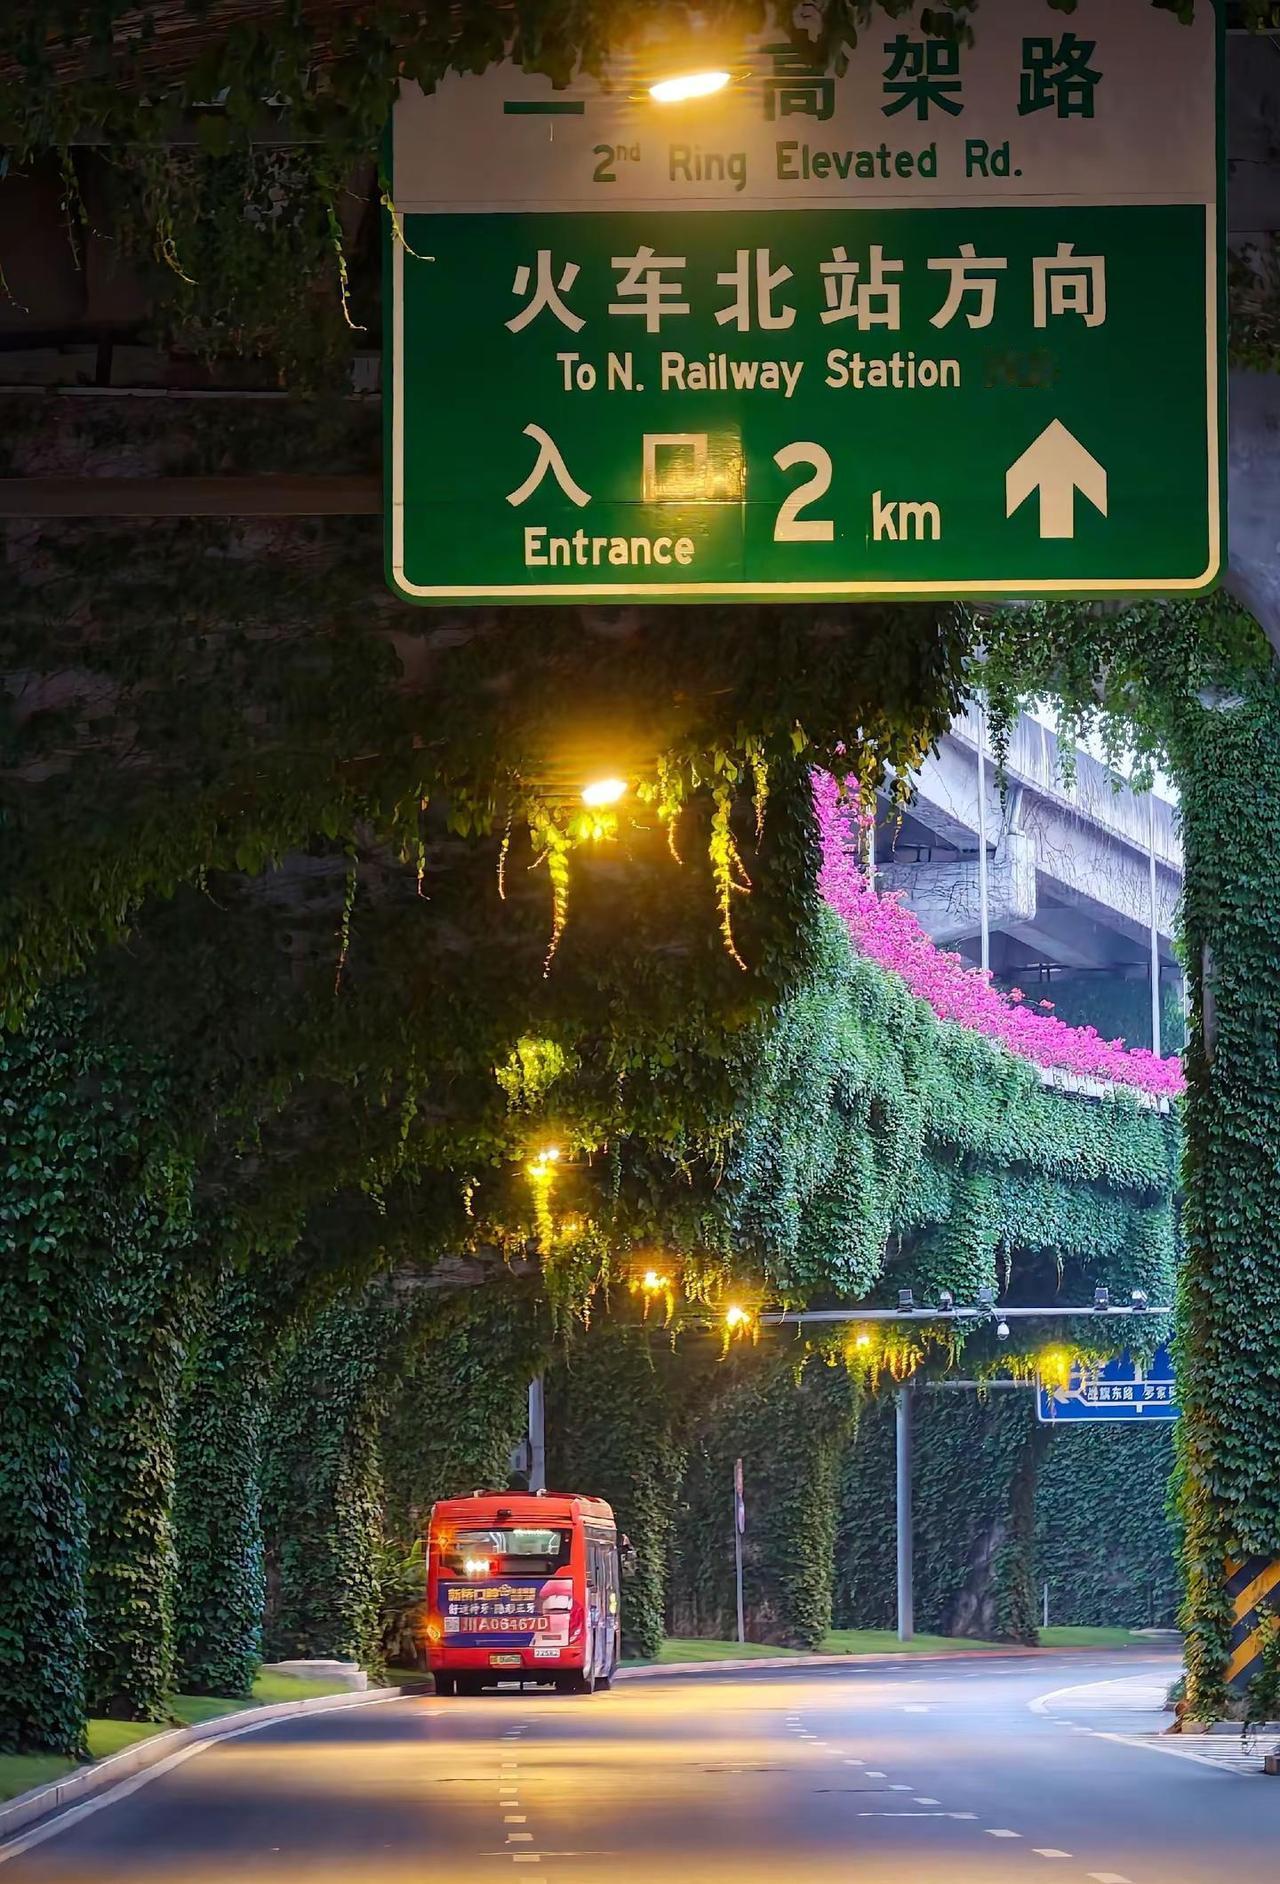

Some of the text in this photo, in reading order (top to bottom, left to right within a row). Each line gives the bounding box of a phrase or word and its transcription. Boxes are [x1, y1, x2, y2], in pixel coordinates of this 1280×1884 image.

[593, 140, 1024, 191] 2nd Ring Elevated Rd.
[505, 243, 1107, 333] 火车北站方向
[556, 350, 961, 397] To N. Railway Station
[506, 424, 941, 542] 入口 2 km
[525, 527, 695, 566] Entrance
